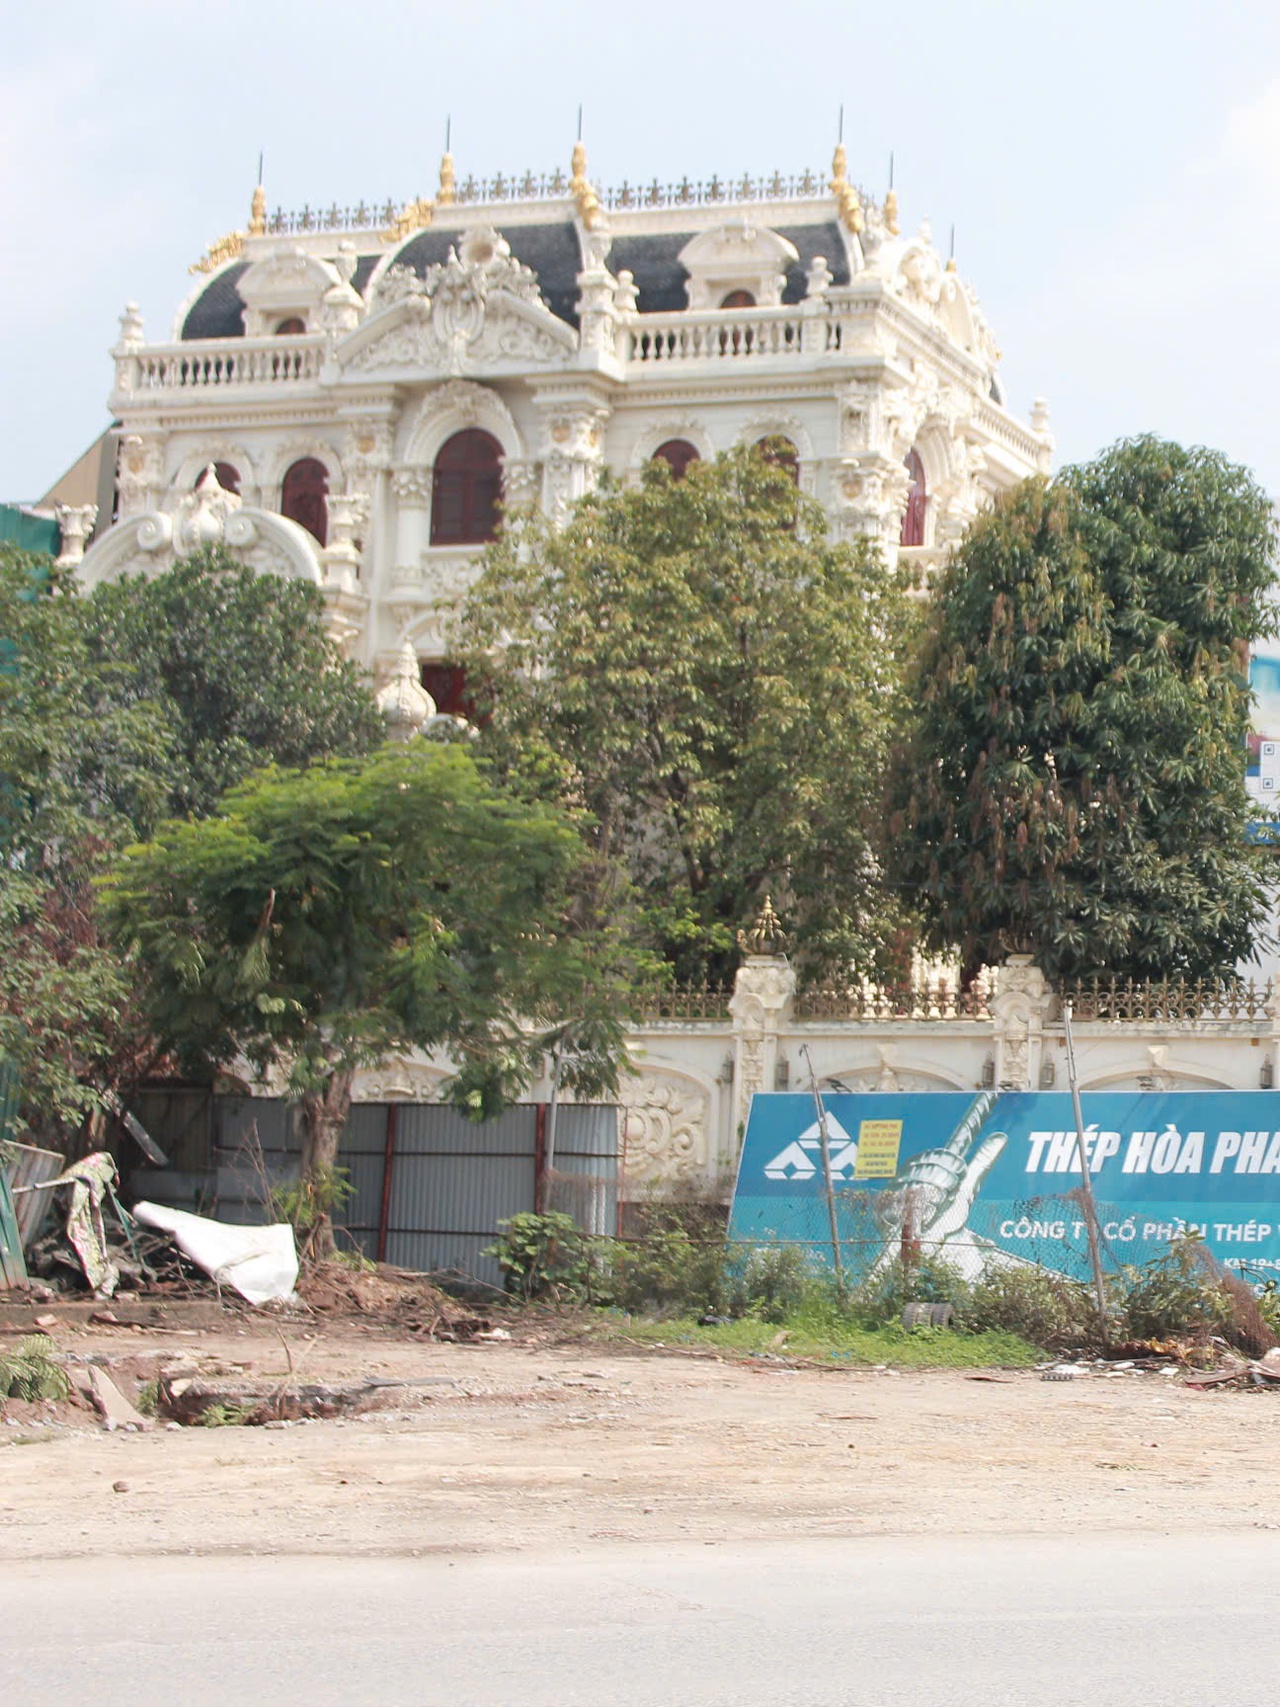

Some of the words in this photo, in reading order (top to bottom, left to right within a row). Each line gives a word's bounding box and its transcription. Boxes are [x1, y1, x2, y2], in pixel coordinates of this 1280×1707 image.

[1024, 1123, 1122, 1174] THÉP
[1121, 1123, 1206, 1174] HÒA
[999, 1216, 1065, 1240] CÔNG
[1142, 1216, 1208, 1241] PHẦN
[1213, 1219, 1272, 1243] THÉP
